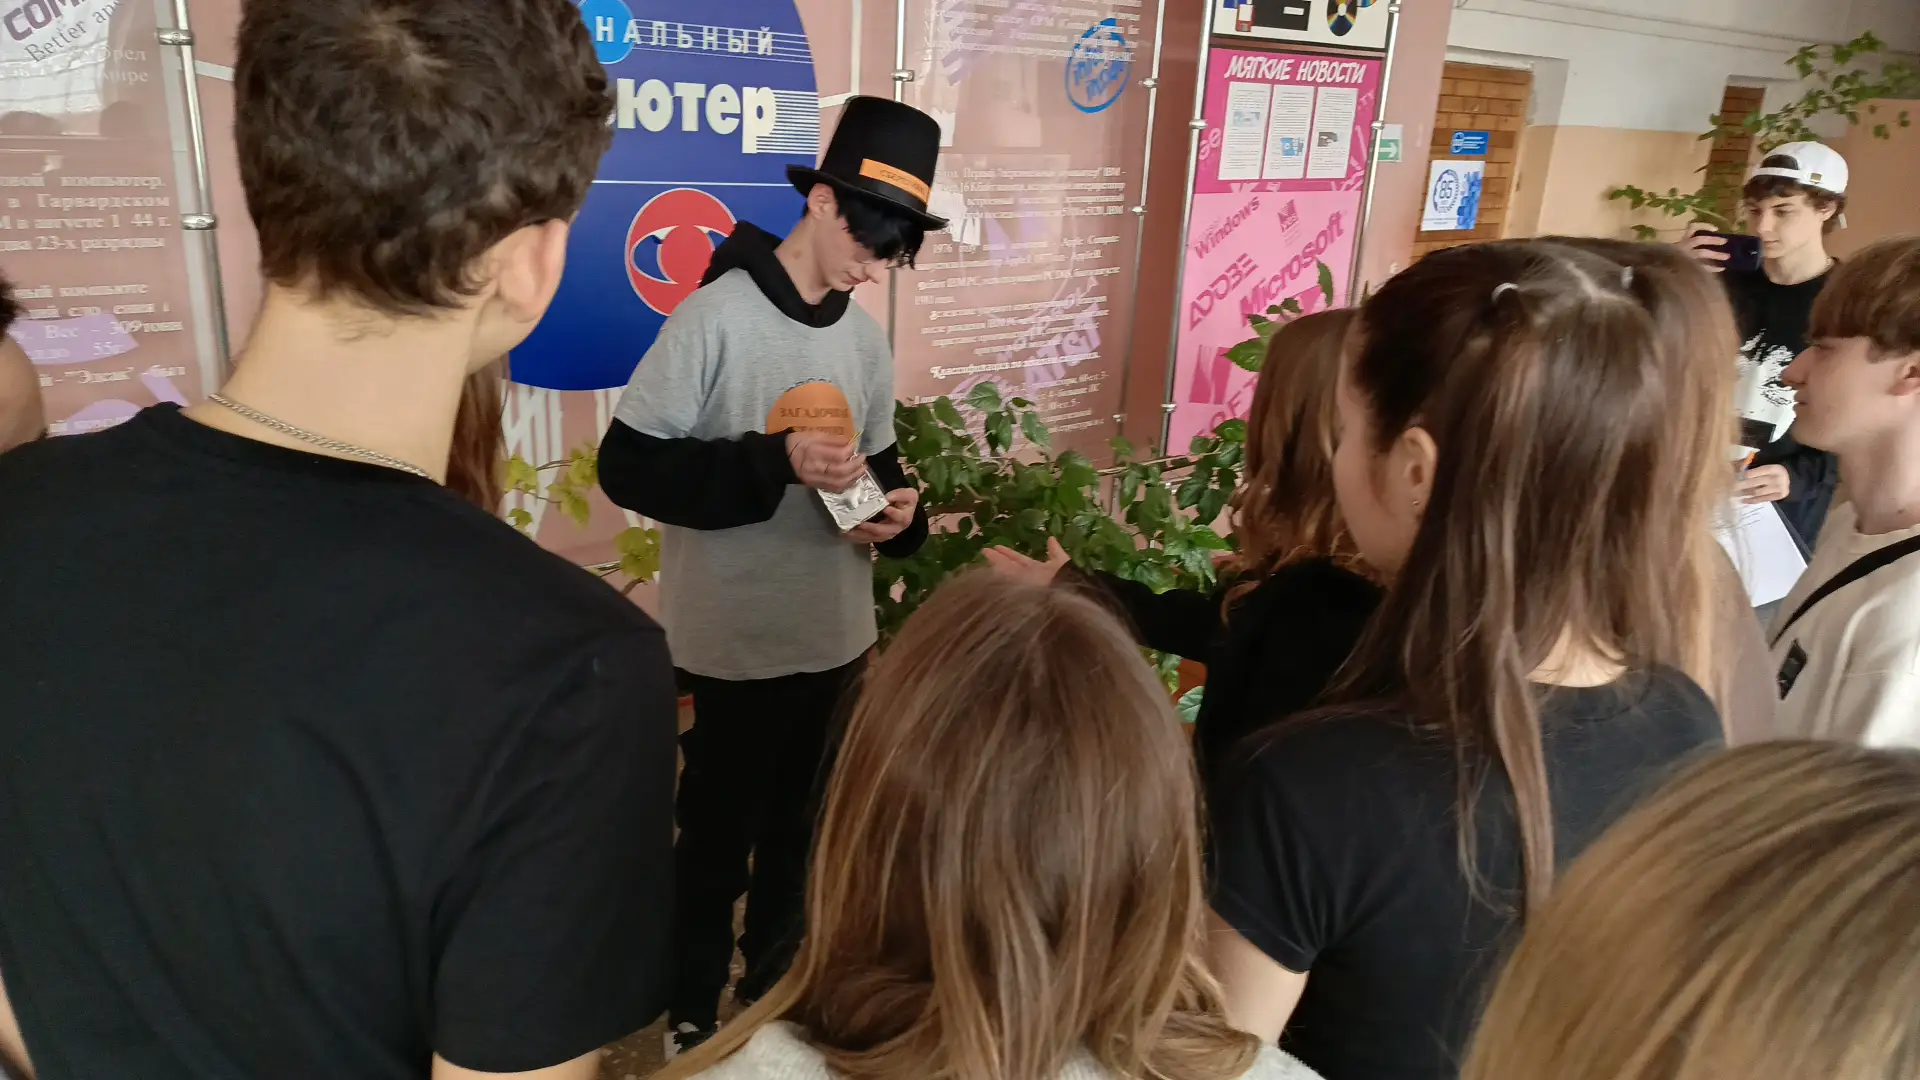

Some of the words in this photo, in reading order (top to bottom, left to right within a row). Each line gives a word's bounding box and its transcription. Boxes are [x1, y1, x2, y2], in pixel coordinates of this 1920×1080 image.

[23, 21, 88, 63] Better
[595, 15, 773, 56] НАЛЬНЫЙ
[1224, 54, 1296, 81] МЯГКИЕ
[1296, 60, 1368, 84] НОВОСТИ
[616, 77, 778, 155] ютер
[37, 193, 171, 211] Гарвардском
[1194, 196, 1261, 260] Windows
[1189, 252, 1260, 332] ADOBE
[1240, 209, 1345, 328] Microsoft
